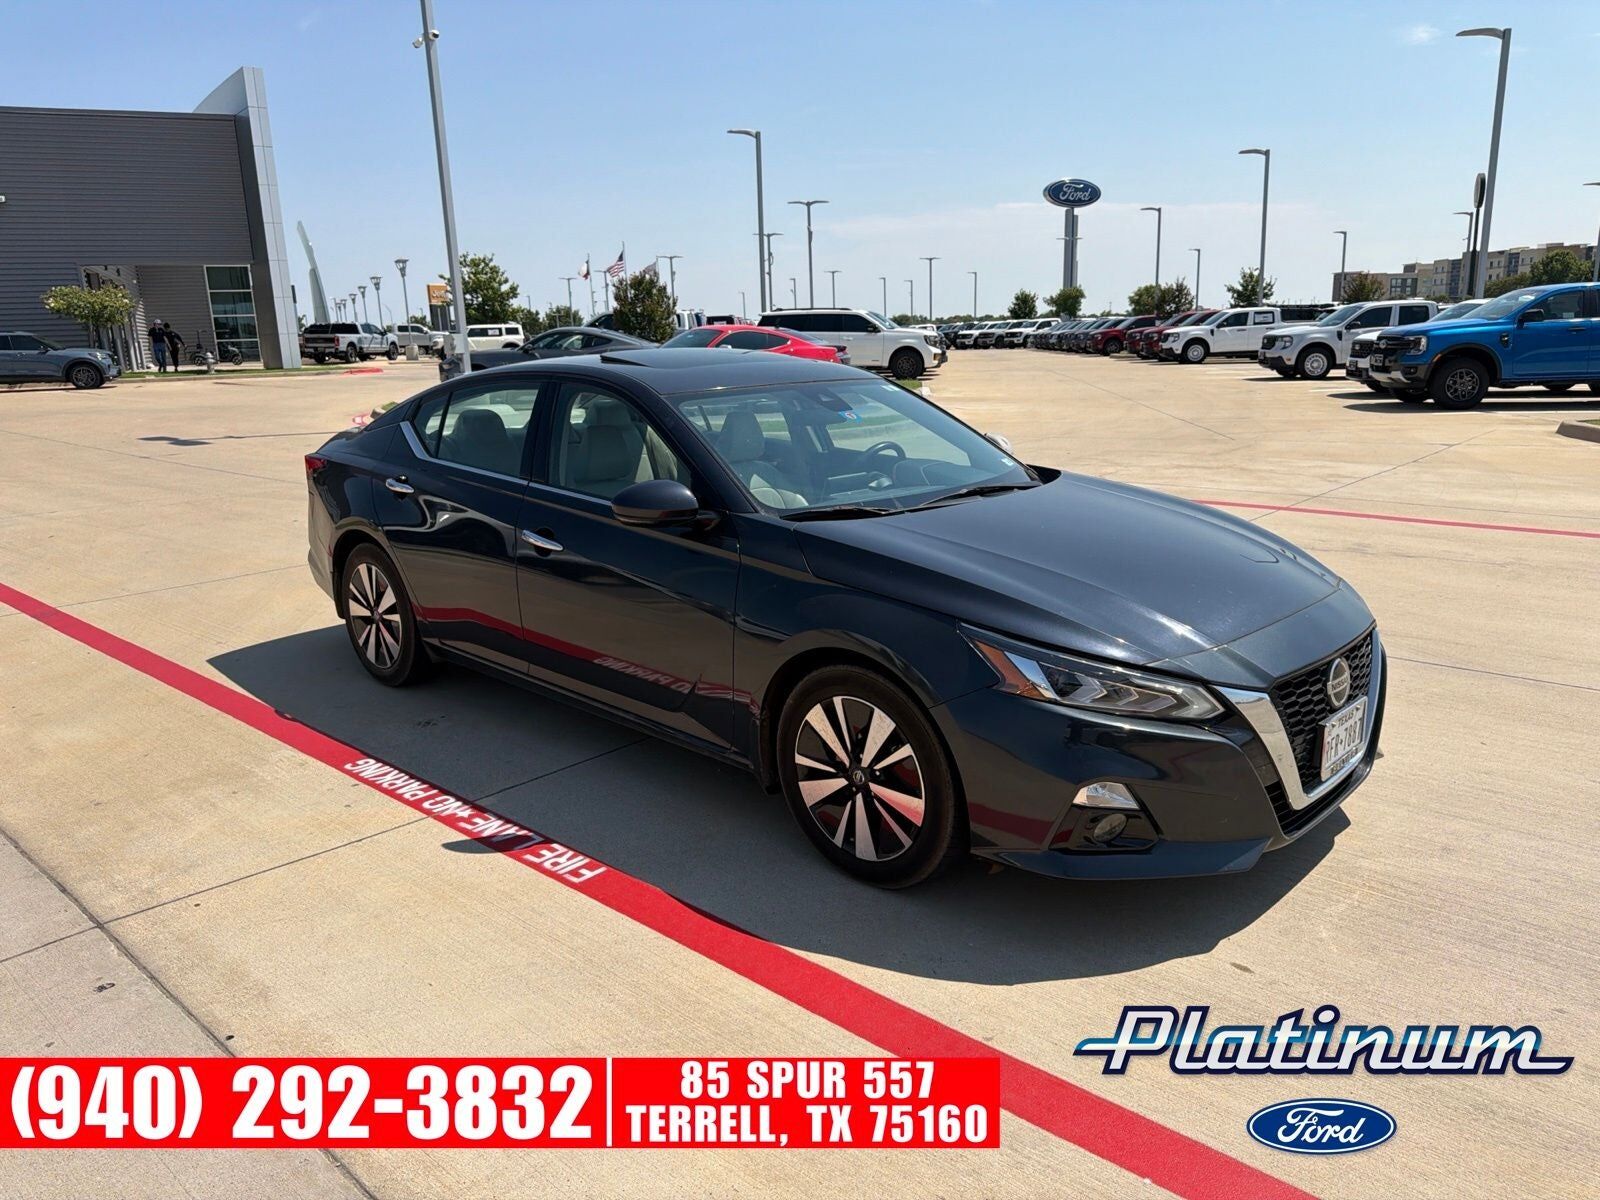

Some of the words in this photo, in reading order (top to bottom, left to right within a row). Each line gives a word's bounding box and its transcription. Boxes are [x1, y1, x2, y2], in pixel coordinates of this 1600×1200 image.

[1059, 183, 1092, 201] Ford
[343, 758, 440, 801] PARKING
[422, 795, 472, 817] NO
[457, 813, 545, 851] LANE
[522, 843, 608, 883] FIRE
